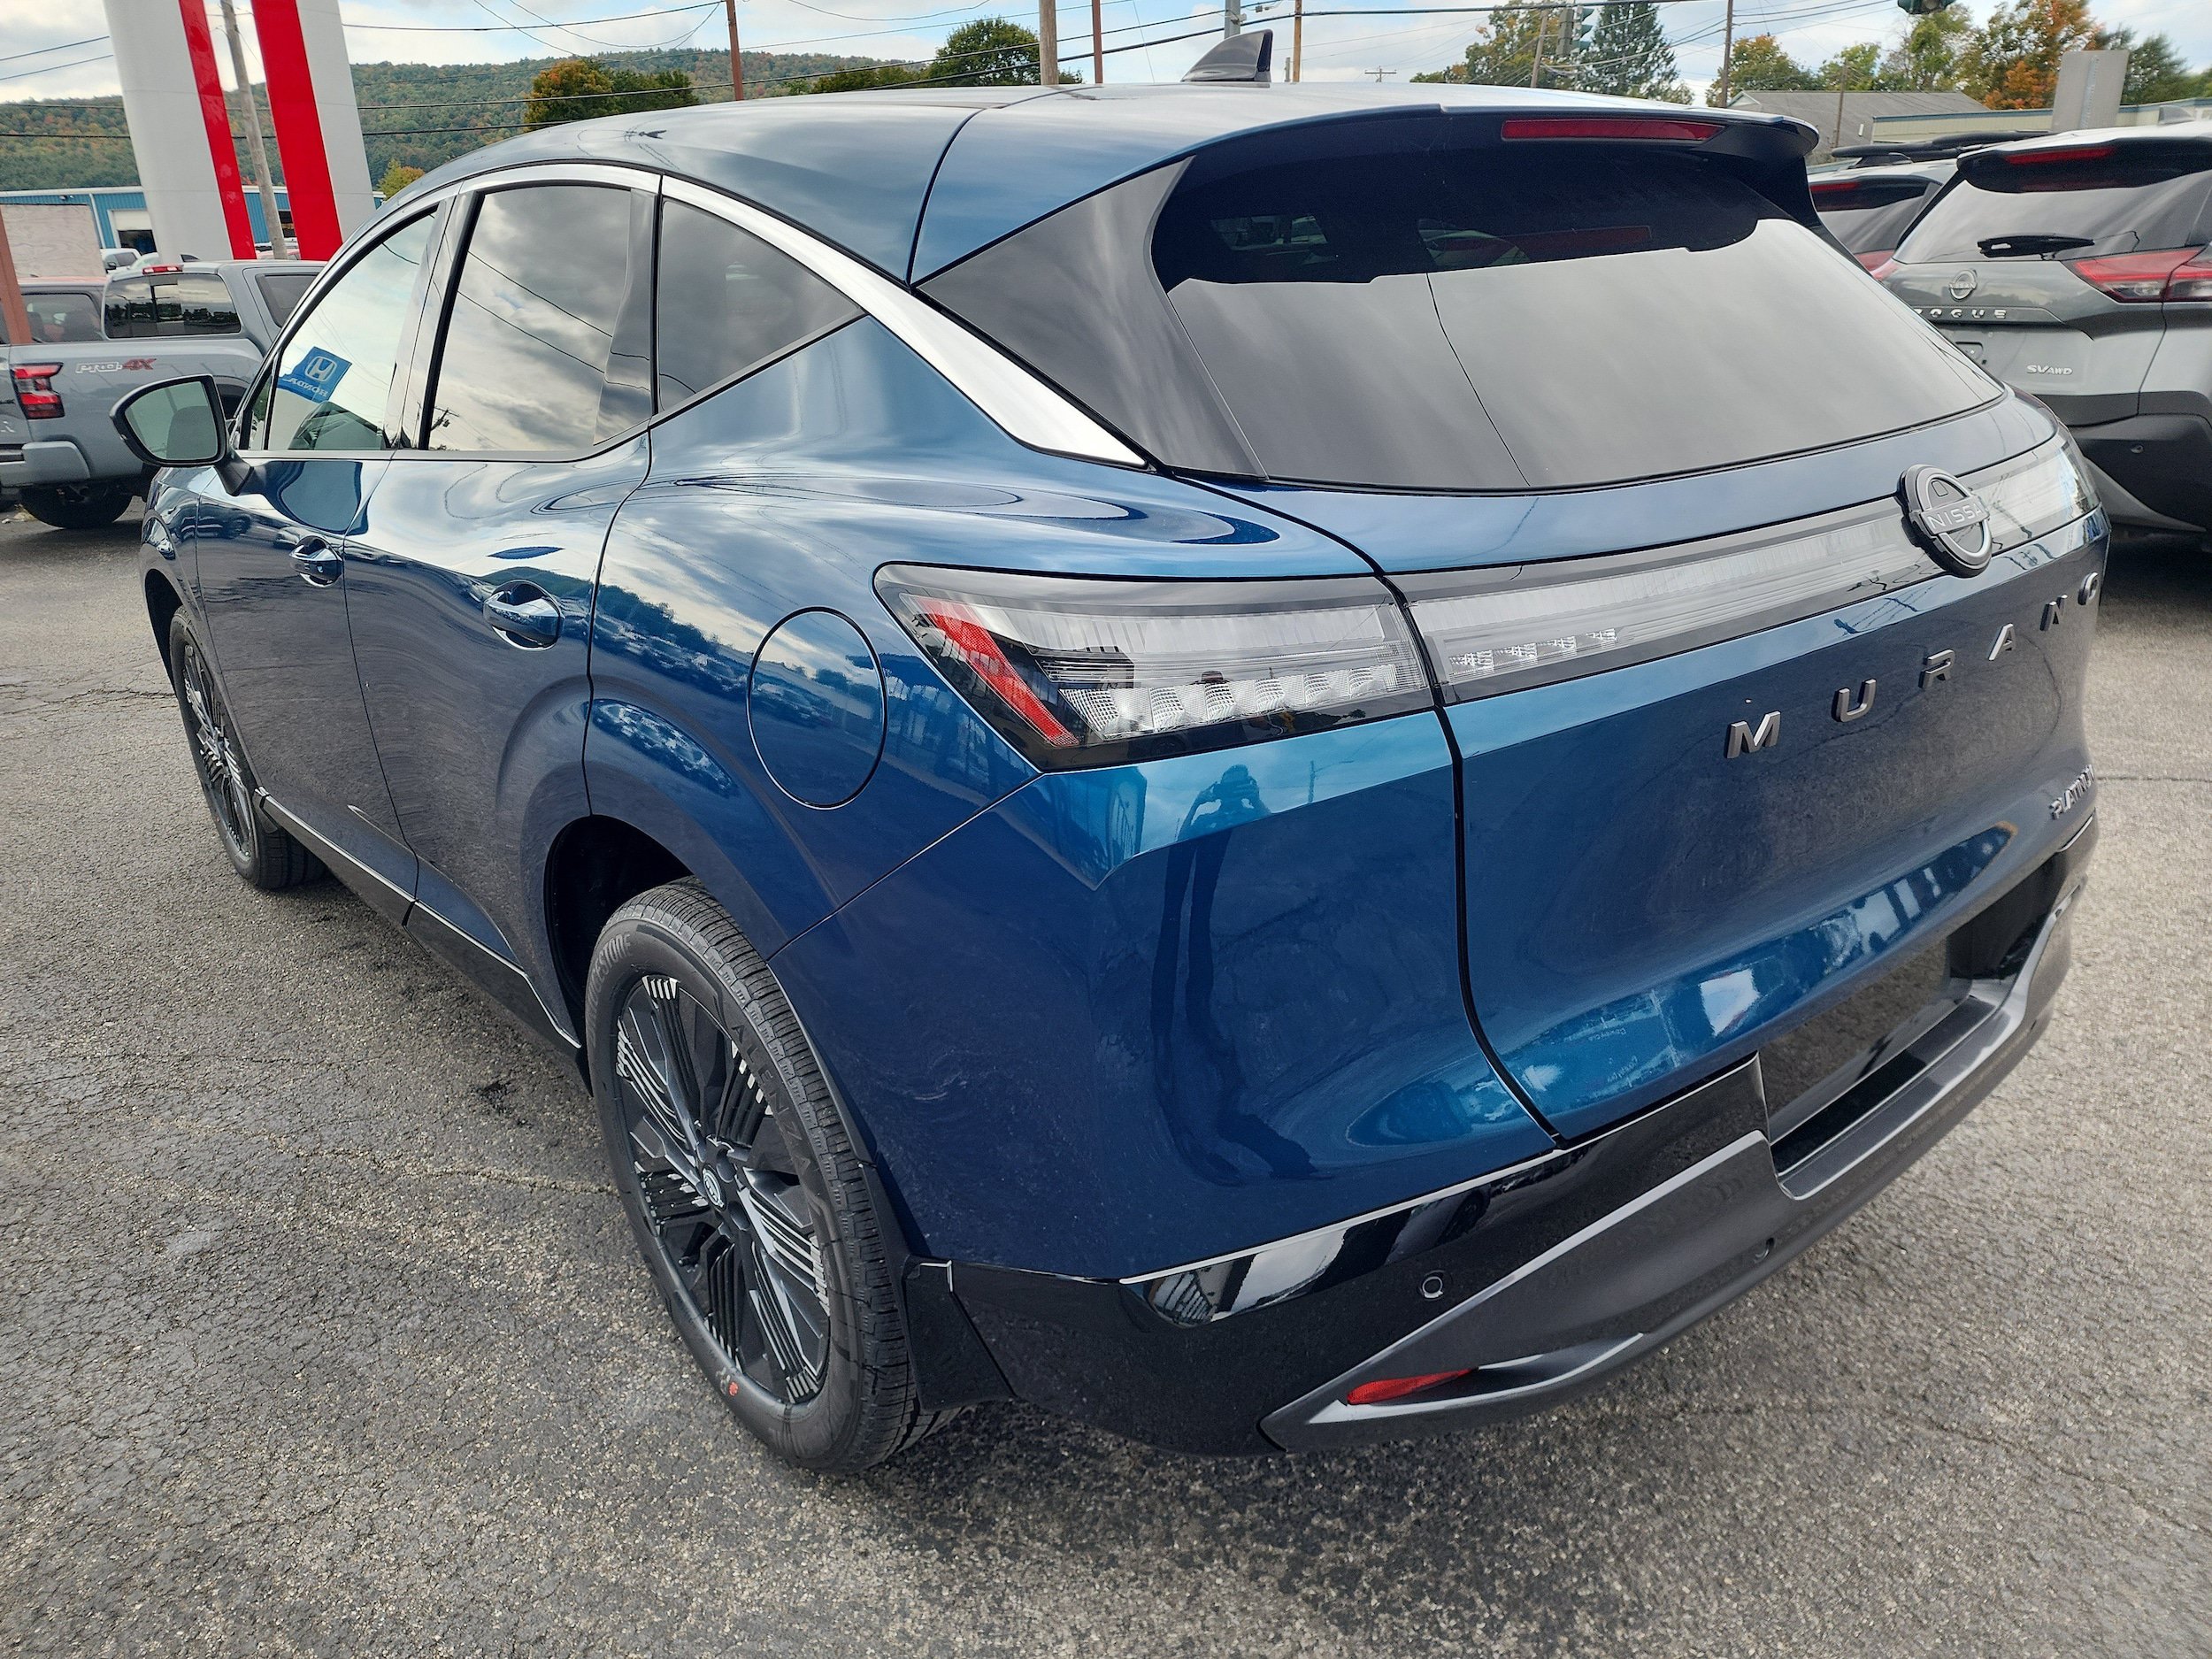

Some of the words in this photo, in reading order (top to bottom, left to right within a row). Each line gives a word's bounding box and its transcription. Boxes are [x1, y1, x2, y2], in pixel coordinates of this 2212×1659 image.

[1927, 502, 1986, 529] NISSA
[1724, 571, 2100, 759] MURANO
[2048, 764, 2095, 820] PLATINU
[730, 1024, 812, 1175] ALENZA
